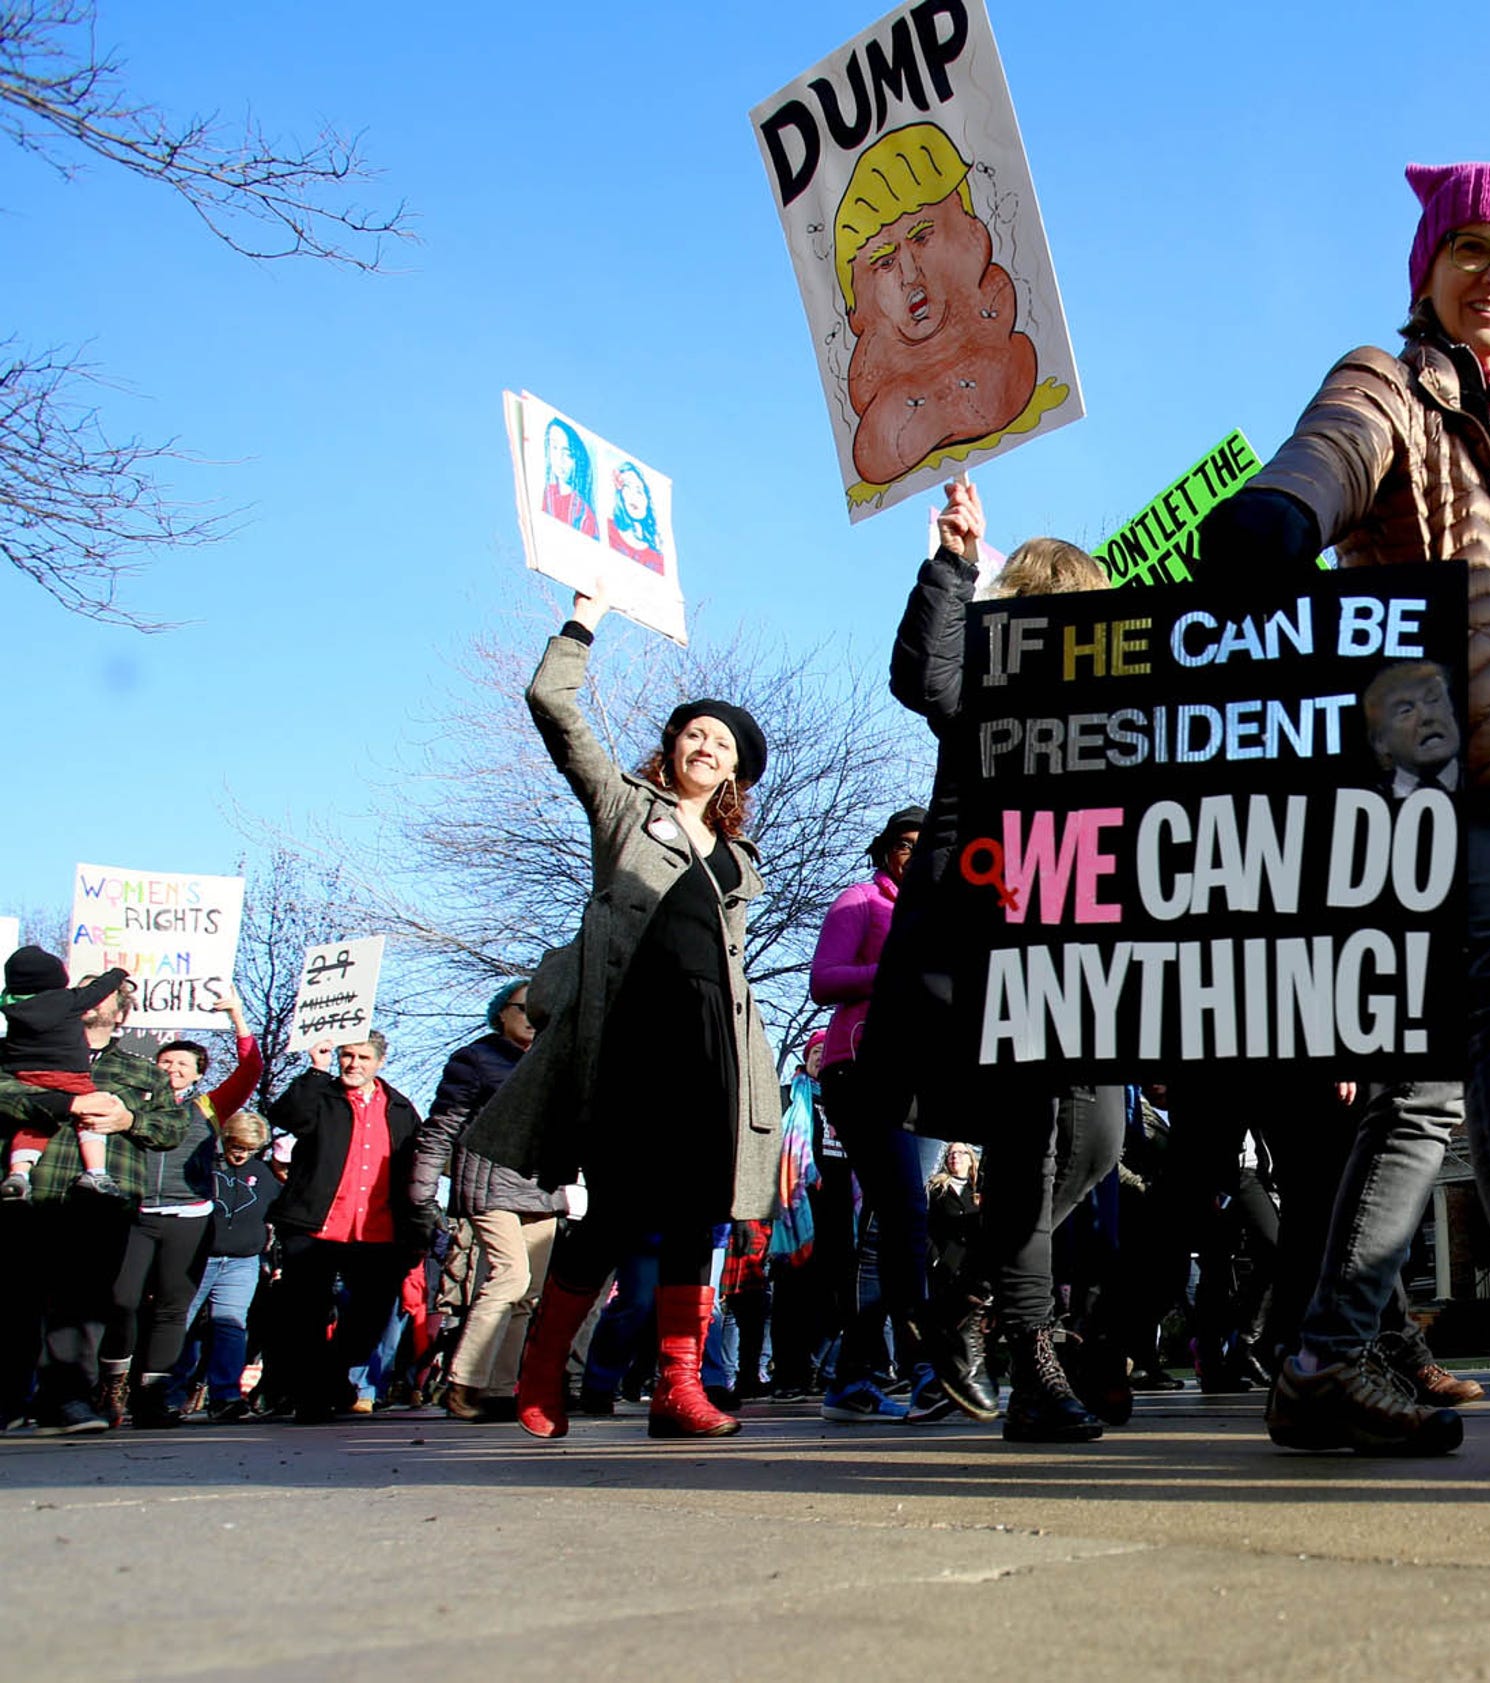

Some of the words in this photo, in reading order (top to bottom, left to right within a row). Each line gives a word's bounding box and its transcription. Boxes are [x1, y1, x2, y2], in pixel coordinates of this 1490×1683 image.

[760, 0, 969, 208] DUMP
[1193, 434, 1256, 499] THE
[982, 611, 1048, 687] IF
[1062, 617, 1152, 681] HE
[1170, 596, 1315, 667] CAN
[1338, 596, 1427, 657] BE
[979, 693, 1357, 779] PRESIDENT
[1002, 807, 1125, 924] WE
[1137, 794, 1307, 921] CAN
[1327, 787, 1458, 913] DO
[73, 924, 121, 947] ARE
[125, 907, 222, 934] RIGHTS
[103, 951, 190, 976] HUMAN
[306, 950, 355, 985] 2.9
[299, 991, 358, 1012] MILLION
[978, 928, 1431, 1065] ANYTHING!
[298, 1008, 365, 1036] VOTES
